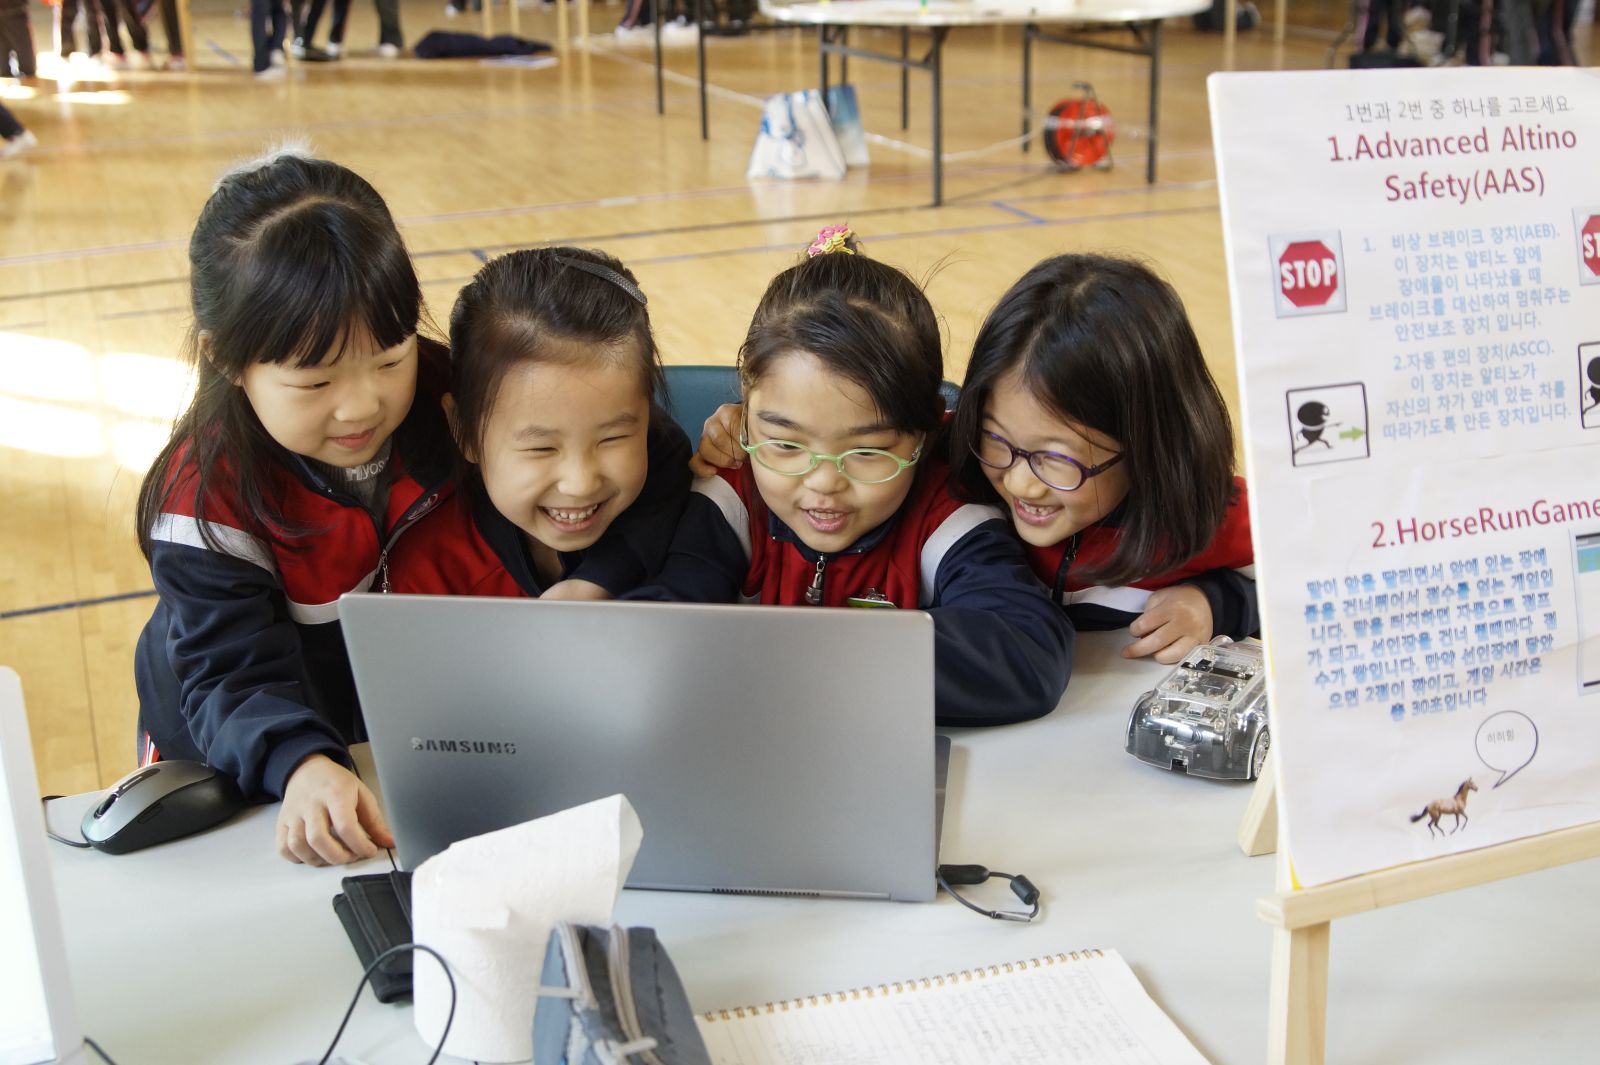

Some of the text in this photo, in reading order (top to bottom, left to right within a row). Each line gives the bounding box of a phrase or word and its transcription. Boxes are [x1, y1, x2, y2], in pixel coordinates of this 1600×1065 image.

[1345, 95, 1575, 123] 1번과 2번 중 하나를 고르세요.
[1329, 124, 1576, 162] 1.Advanced Altino
[1385, 166, 1545, 205] Safety(AAS)
[1363, 223, 1560, 252] 1. 비상 브레이크 장치(AEB).
[1281, 258, 1336, 290] STOP
[1395, 246, 1542, 273] 이 장치는 알티노 앞에
[1399, 267, 1542, 296] 장애물이 나타났을 때
[1369, 287, 1571, 320] 브레이크를 대신하여 멈춰주는
[1395, 312, 1540, 342] 안전보조 장치 입니다.
[1393, 340, 1554, 371] 2.자동 편의 장치(ASCC).
[1411, 362, 1536, 392] 이 장치는 알티노가
[1387, 380, 1566, 417] 자신의 차가 앞에 있는 차를
[1383, 403, 1572, 440] 따라가도록 만든 장치입니다.
[345, 460, 387, 481] Hyos
[1485, 554, 1514, 573] 있는
[1519, 548, 1547, 569] 장애
[1308, 649, 1322, 667] 가
[1439, 626, 1468, 647] 건너
[1315, 667, 1346, 689] 수가
[1329, 688, 1359, 709] 으면
[1500, 657, 1542, 679] 시간은
[411, 737, 517, 754] SAMSUNG
